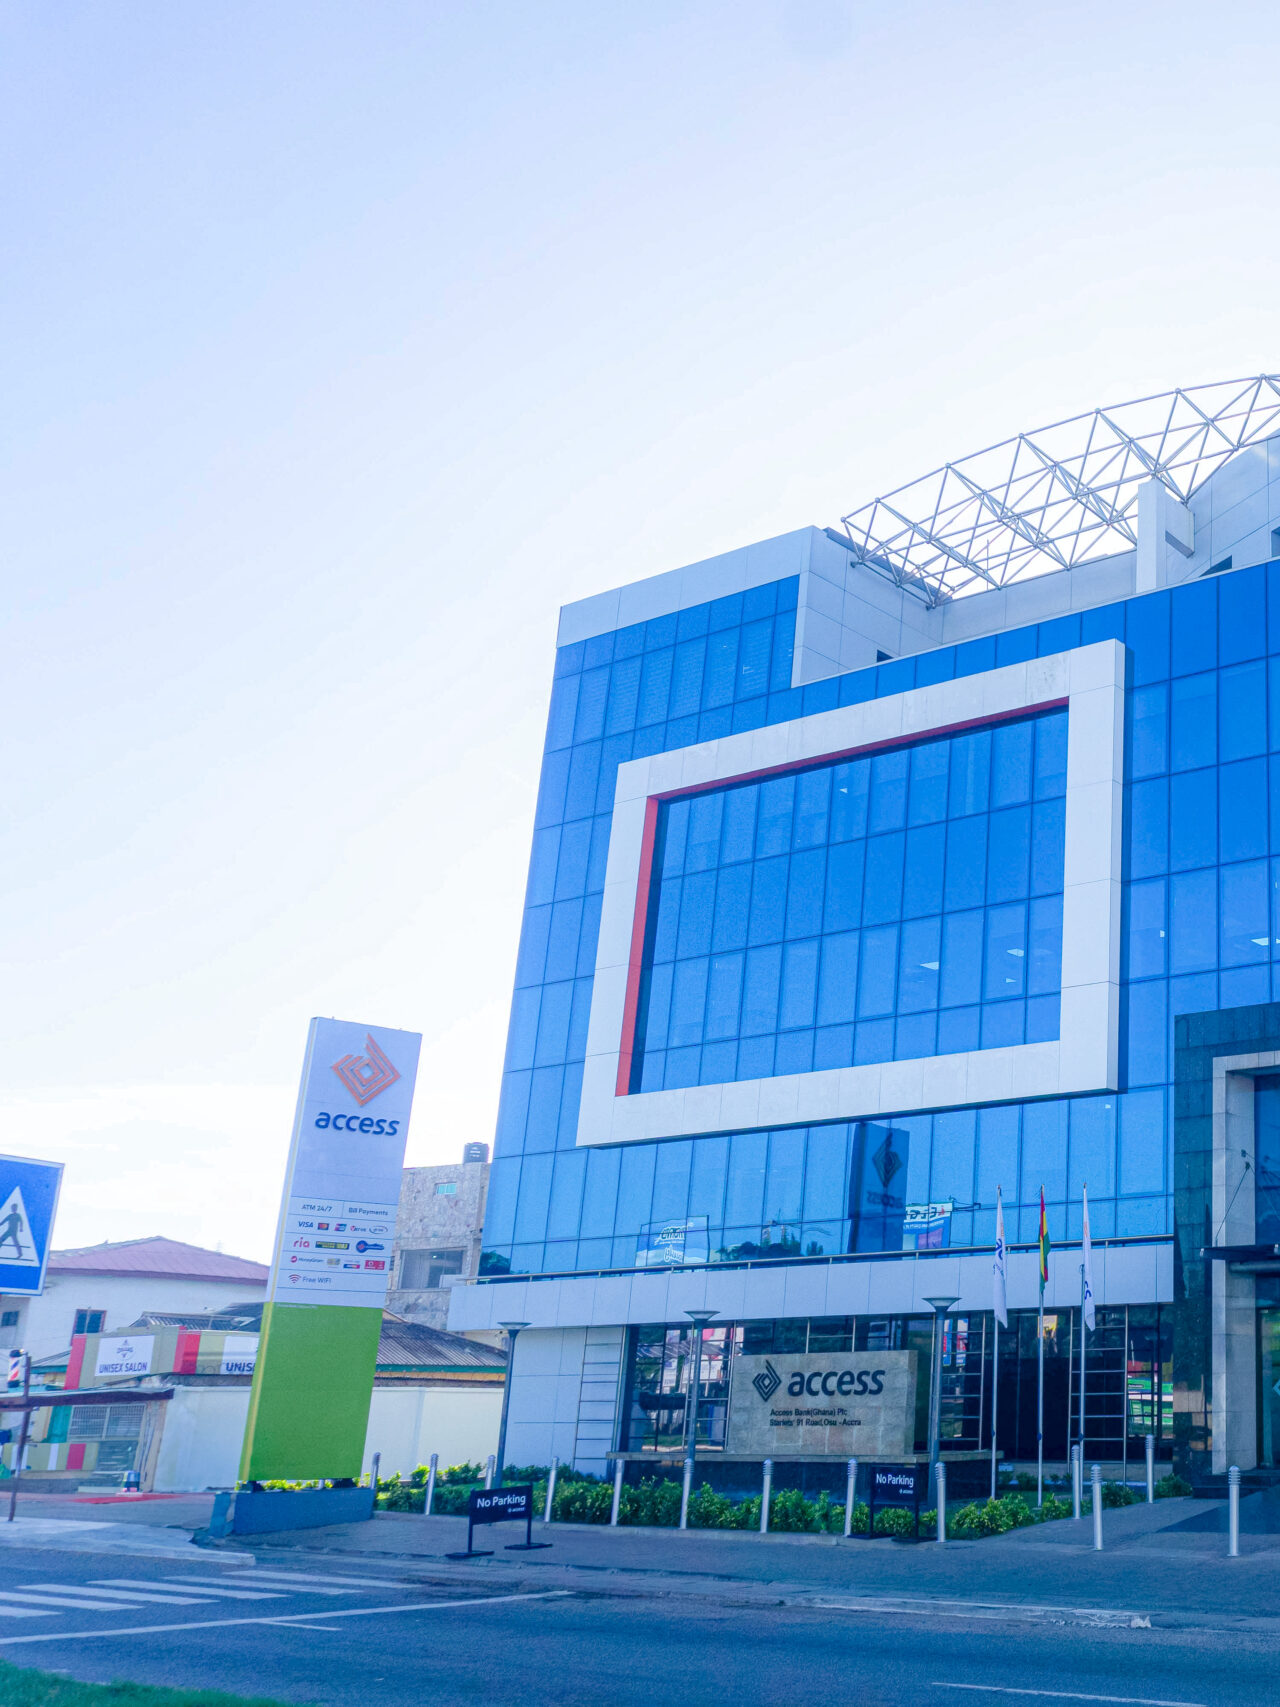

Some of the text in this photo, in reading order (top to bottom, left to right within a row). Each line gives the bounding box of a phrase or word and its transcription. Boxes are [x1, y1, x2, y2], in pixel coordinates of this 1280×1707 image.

[315, 1111, 400, 1136] access
[316, 1205, 333, 1213] 24/7
[358, 1208, 389, 1216] Payments
[293, 1236, 310, 1248] ria
[99, 1361, 148, 1373] UNISEX SALON
[787, 1369, 886, 1397] access
[770, 1408, 793, 1416] Access
[876, 1473, 914, 1488] No Parking
[477, 1494, 527, 1509] No Parking
